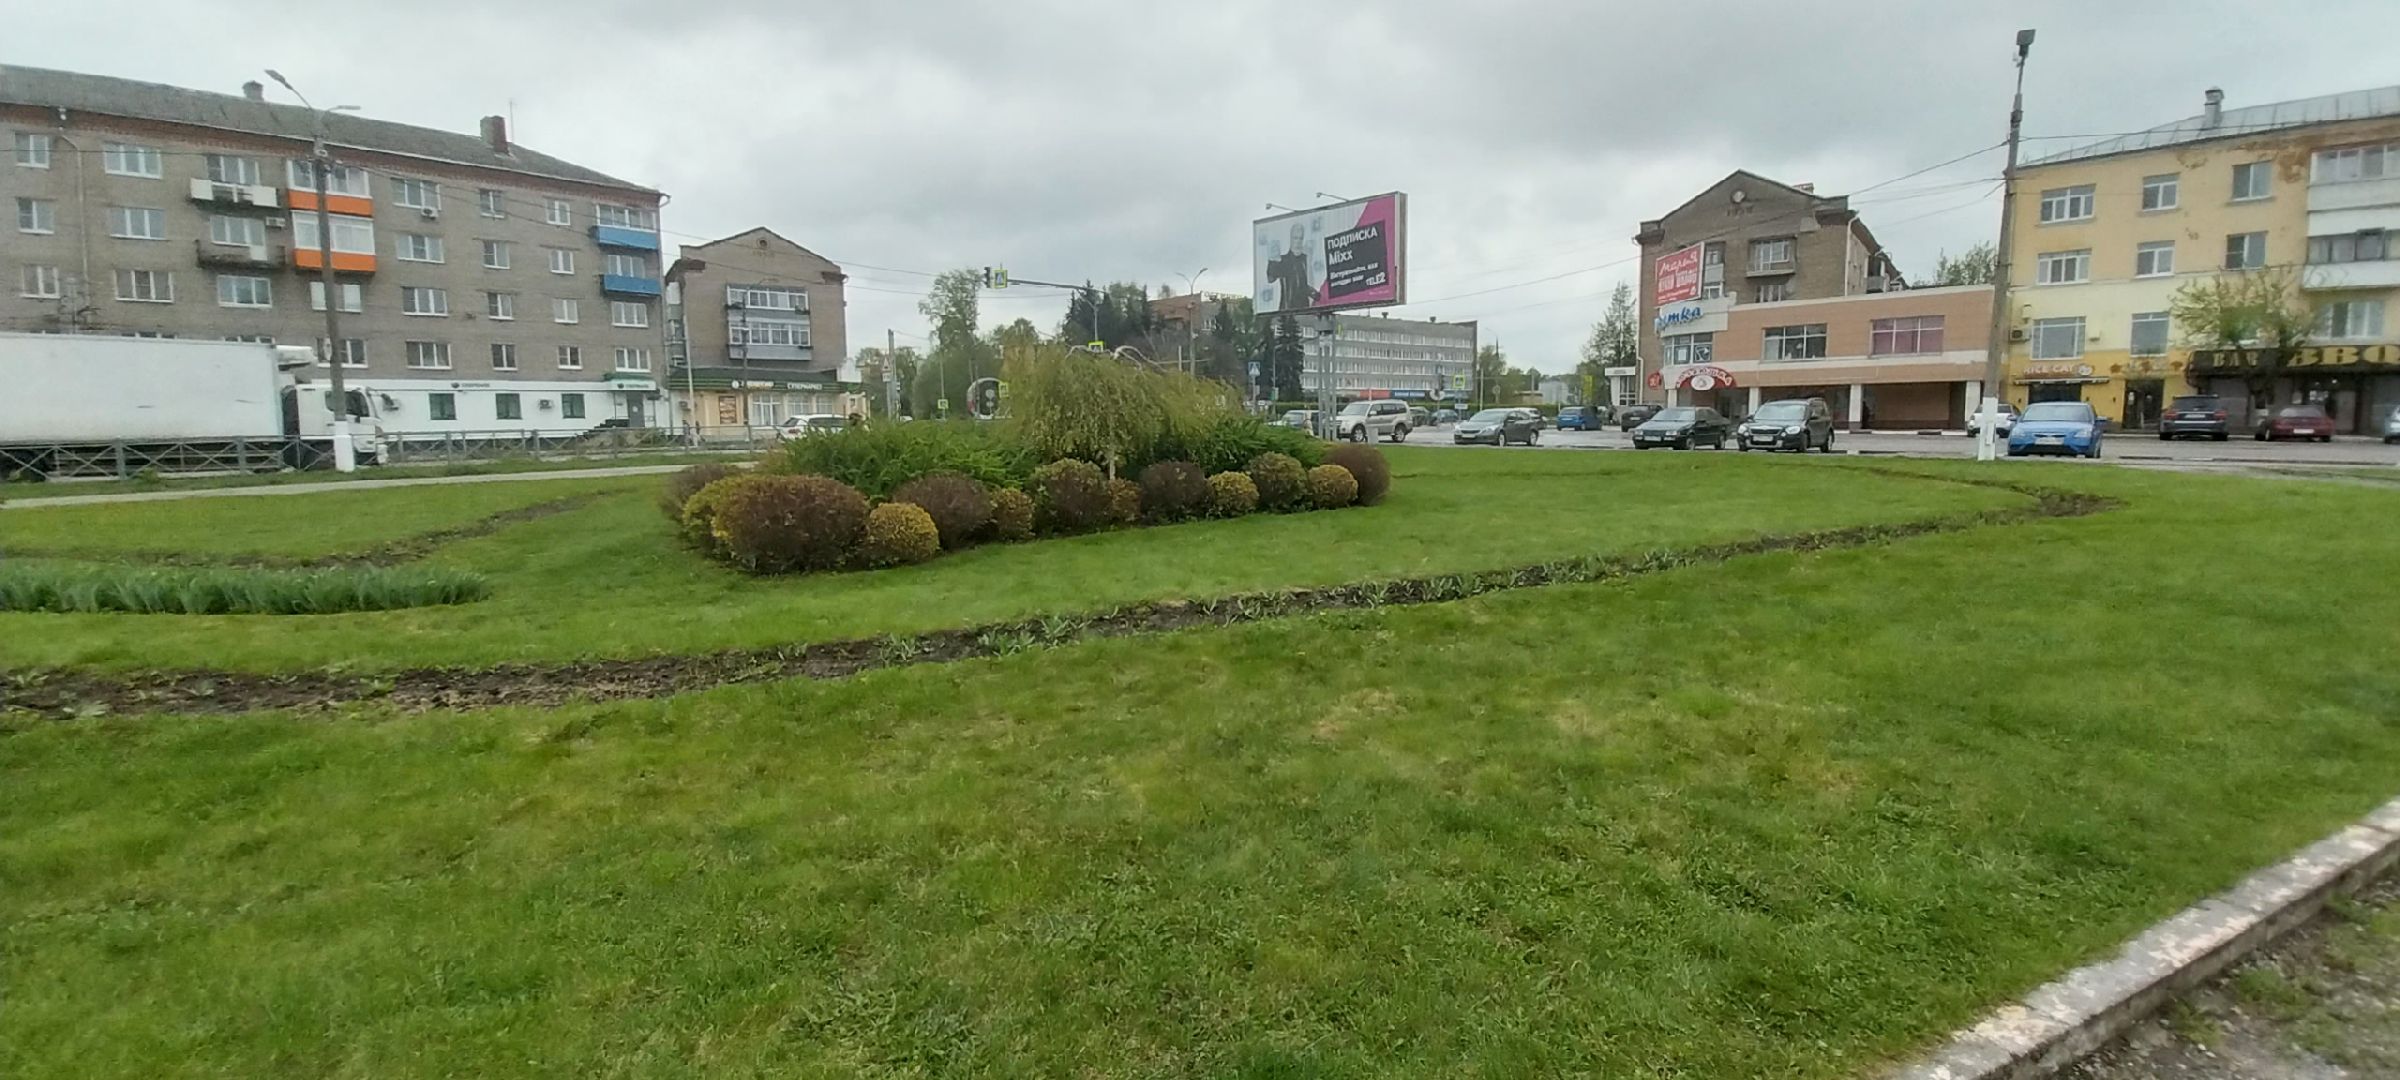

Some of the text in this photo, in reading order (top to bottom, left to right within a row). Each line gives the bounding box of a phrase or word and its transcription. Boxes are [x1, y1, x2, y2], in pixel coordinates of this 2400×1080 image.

[1327, 226, 1378, 250] ПОДПИСКА
[1328, 250, 1353, 265] Mixx
[1366, 272, 1386, 286] TELE2
[2053, 364, 2074, 374] CAT
